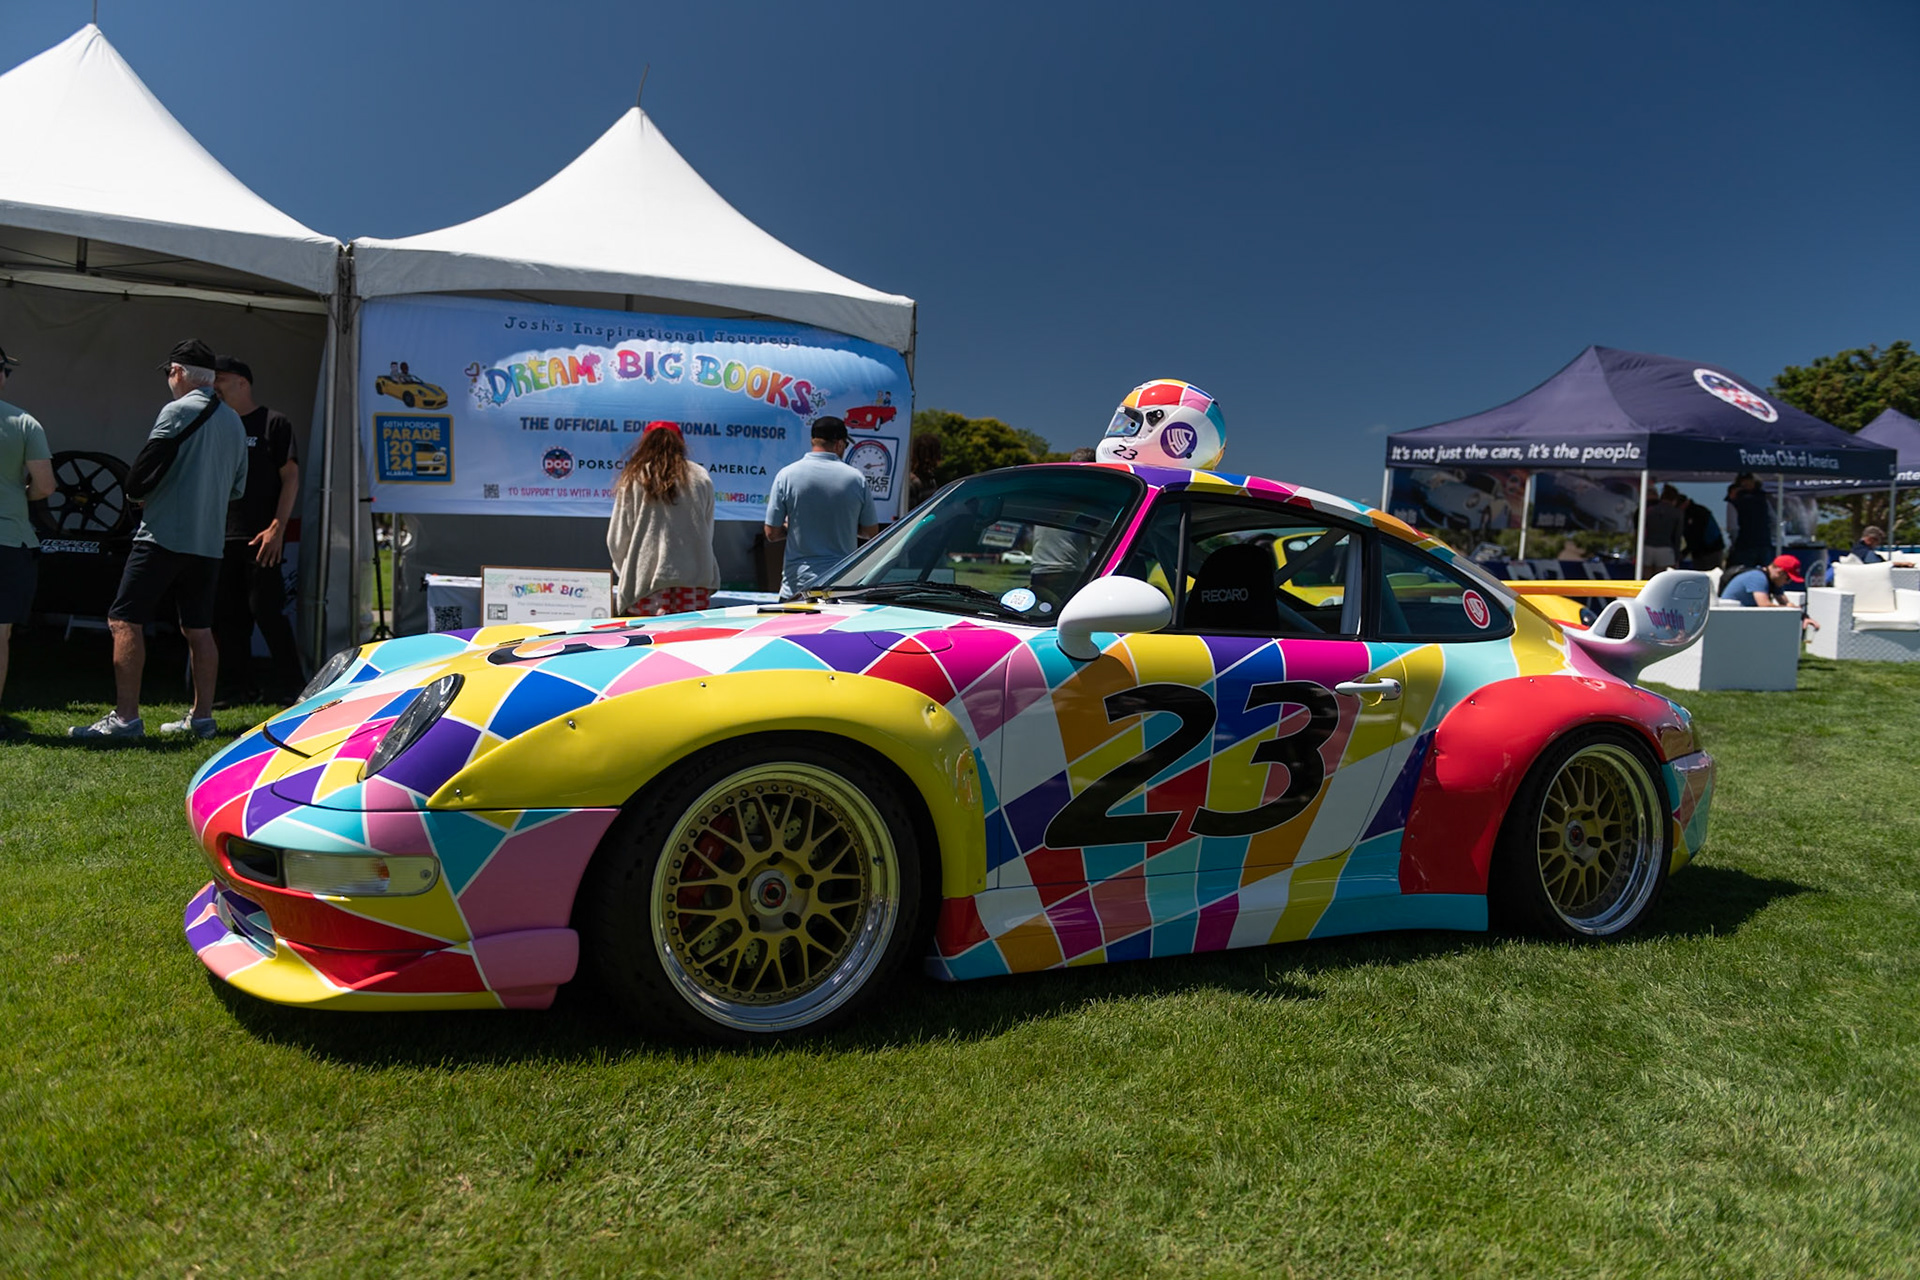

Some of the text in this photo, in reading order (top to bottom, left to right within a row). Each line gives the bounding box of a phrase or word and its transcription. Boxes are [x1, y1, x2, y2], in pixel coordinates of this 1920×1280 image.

[504, 316, 800, 348] Josh's Inspirational Journeys
[485, 350, 813, 416] DREAM BIG BOOKS
[404, 421, 440, 429] PORSCHE
[520, 417, 549, 430] THE
[554, 418, 618, 432] OFFICIAL
[726, 424, 787, 440] SPONSOR
[383, 428, 441, 441] PARADE
[389, 441, 413, 455] 20
[1112, 444, 1138, 460] 23
[1391, 442, 1640, 463] It's not just the cars, it's the people
[390, 456, 413, 470] 24
[544, 458, 572, 470] pca
[1739, 449, 1776, 466] Porsche
[1776, 450, 1797, 467] Club
[1808, 453, 1839, 469] America
[709, 463, 767, 476] AMERICA
[508, 487, 519, 496] TO
[521, 487, 555, 497] SUPPORT
[557, 487, 568, 498] US
[569, 487, 591, 498] WITH
[593, 488, 600, 498] A
[514, 582, 585, 598] DREAM BIG
[1201, 587, 1249, 602] RECARO
[1043, 680, 1339, 850] 23
